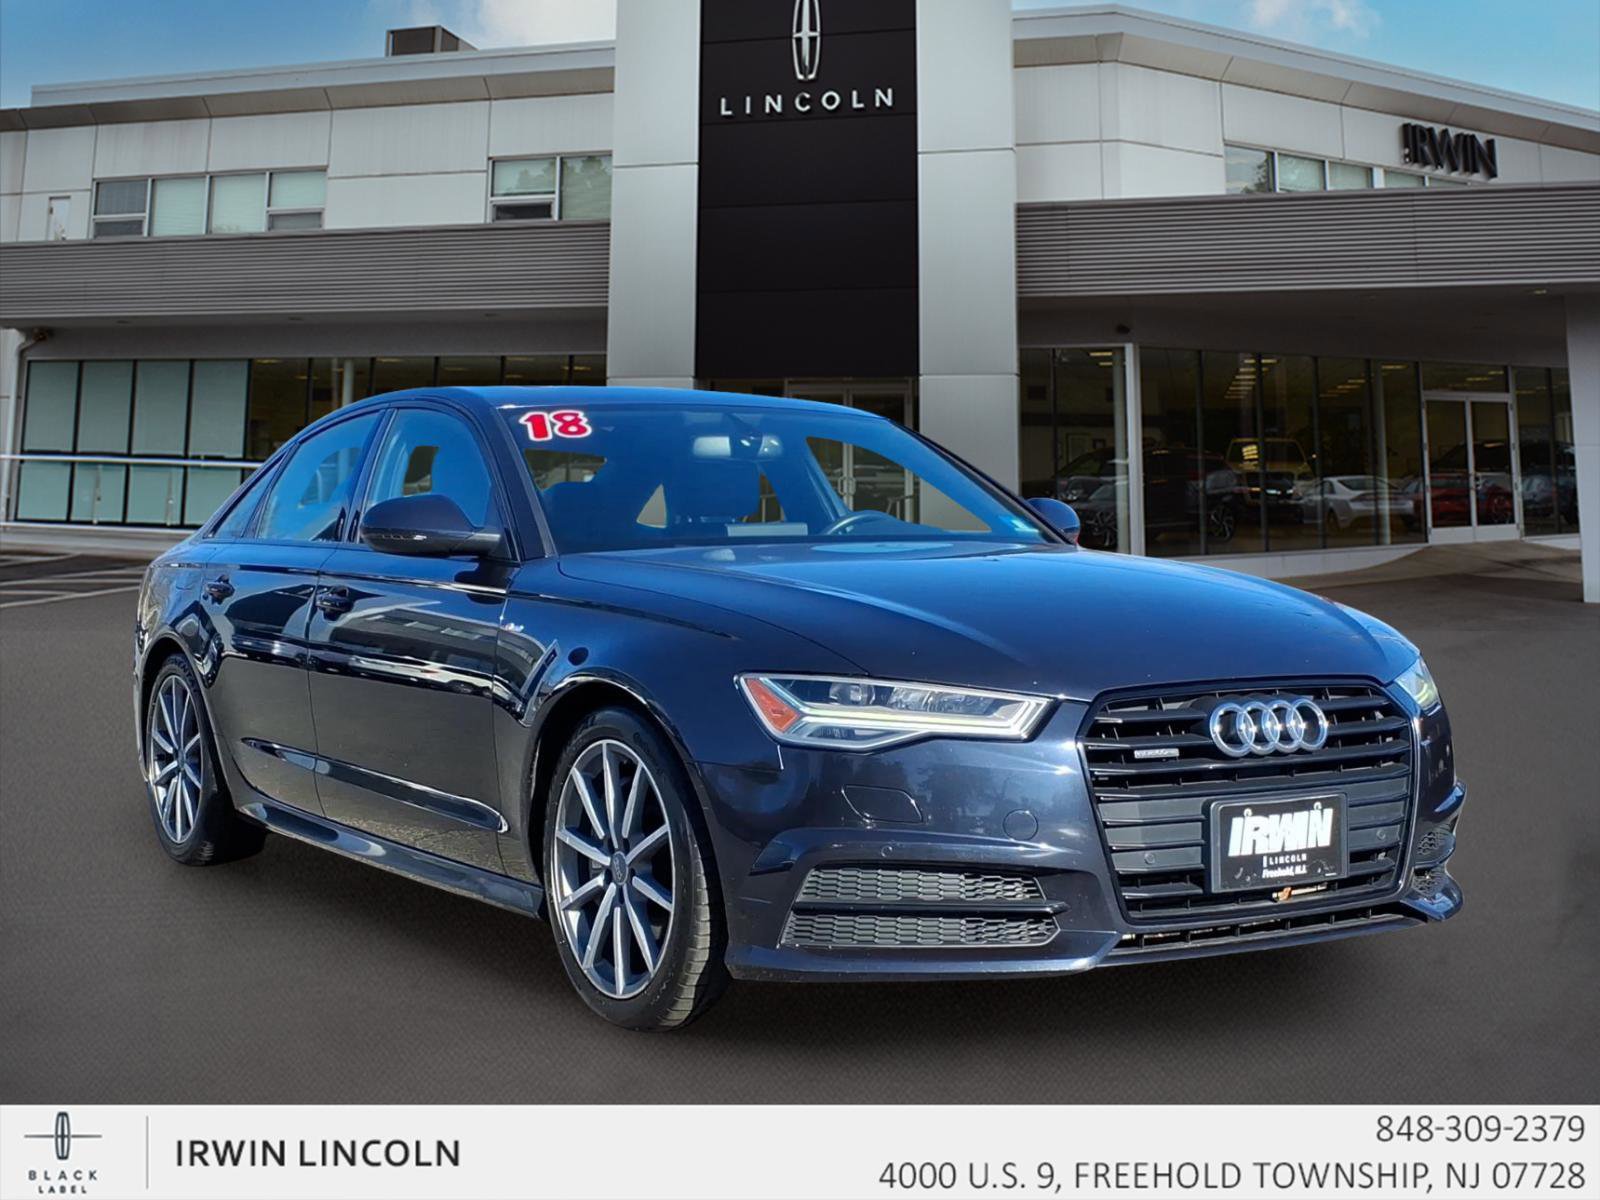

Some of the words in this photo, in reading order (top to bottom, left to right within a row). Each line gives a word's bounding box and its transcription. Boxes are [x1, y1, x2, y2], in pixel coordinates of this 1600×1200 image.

[720, 87, 893, 116] LINCOLN
[1401, 122, 1498, 179] IRWIN
[518, 409, 592, 441] 18
[1228, 808, 1333, 856] IRWIN
[1269, 853, 1307, 865] LINCOLN
